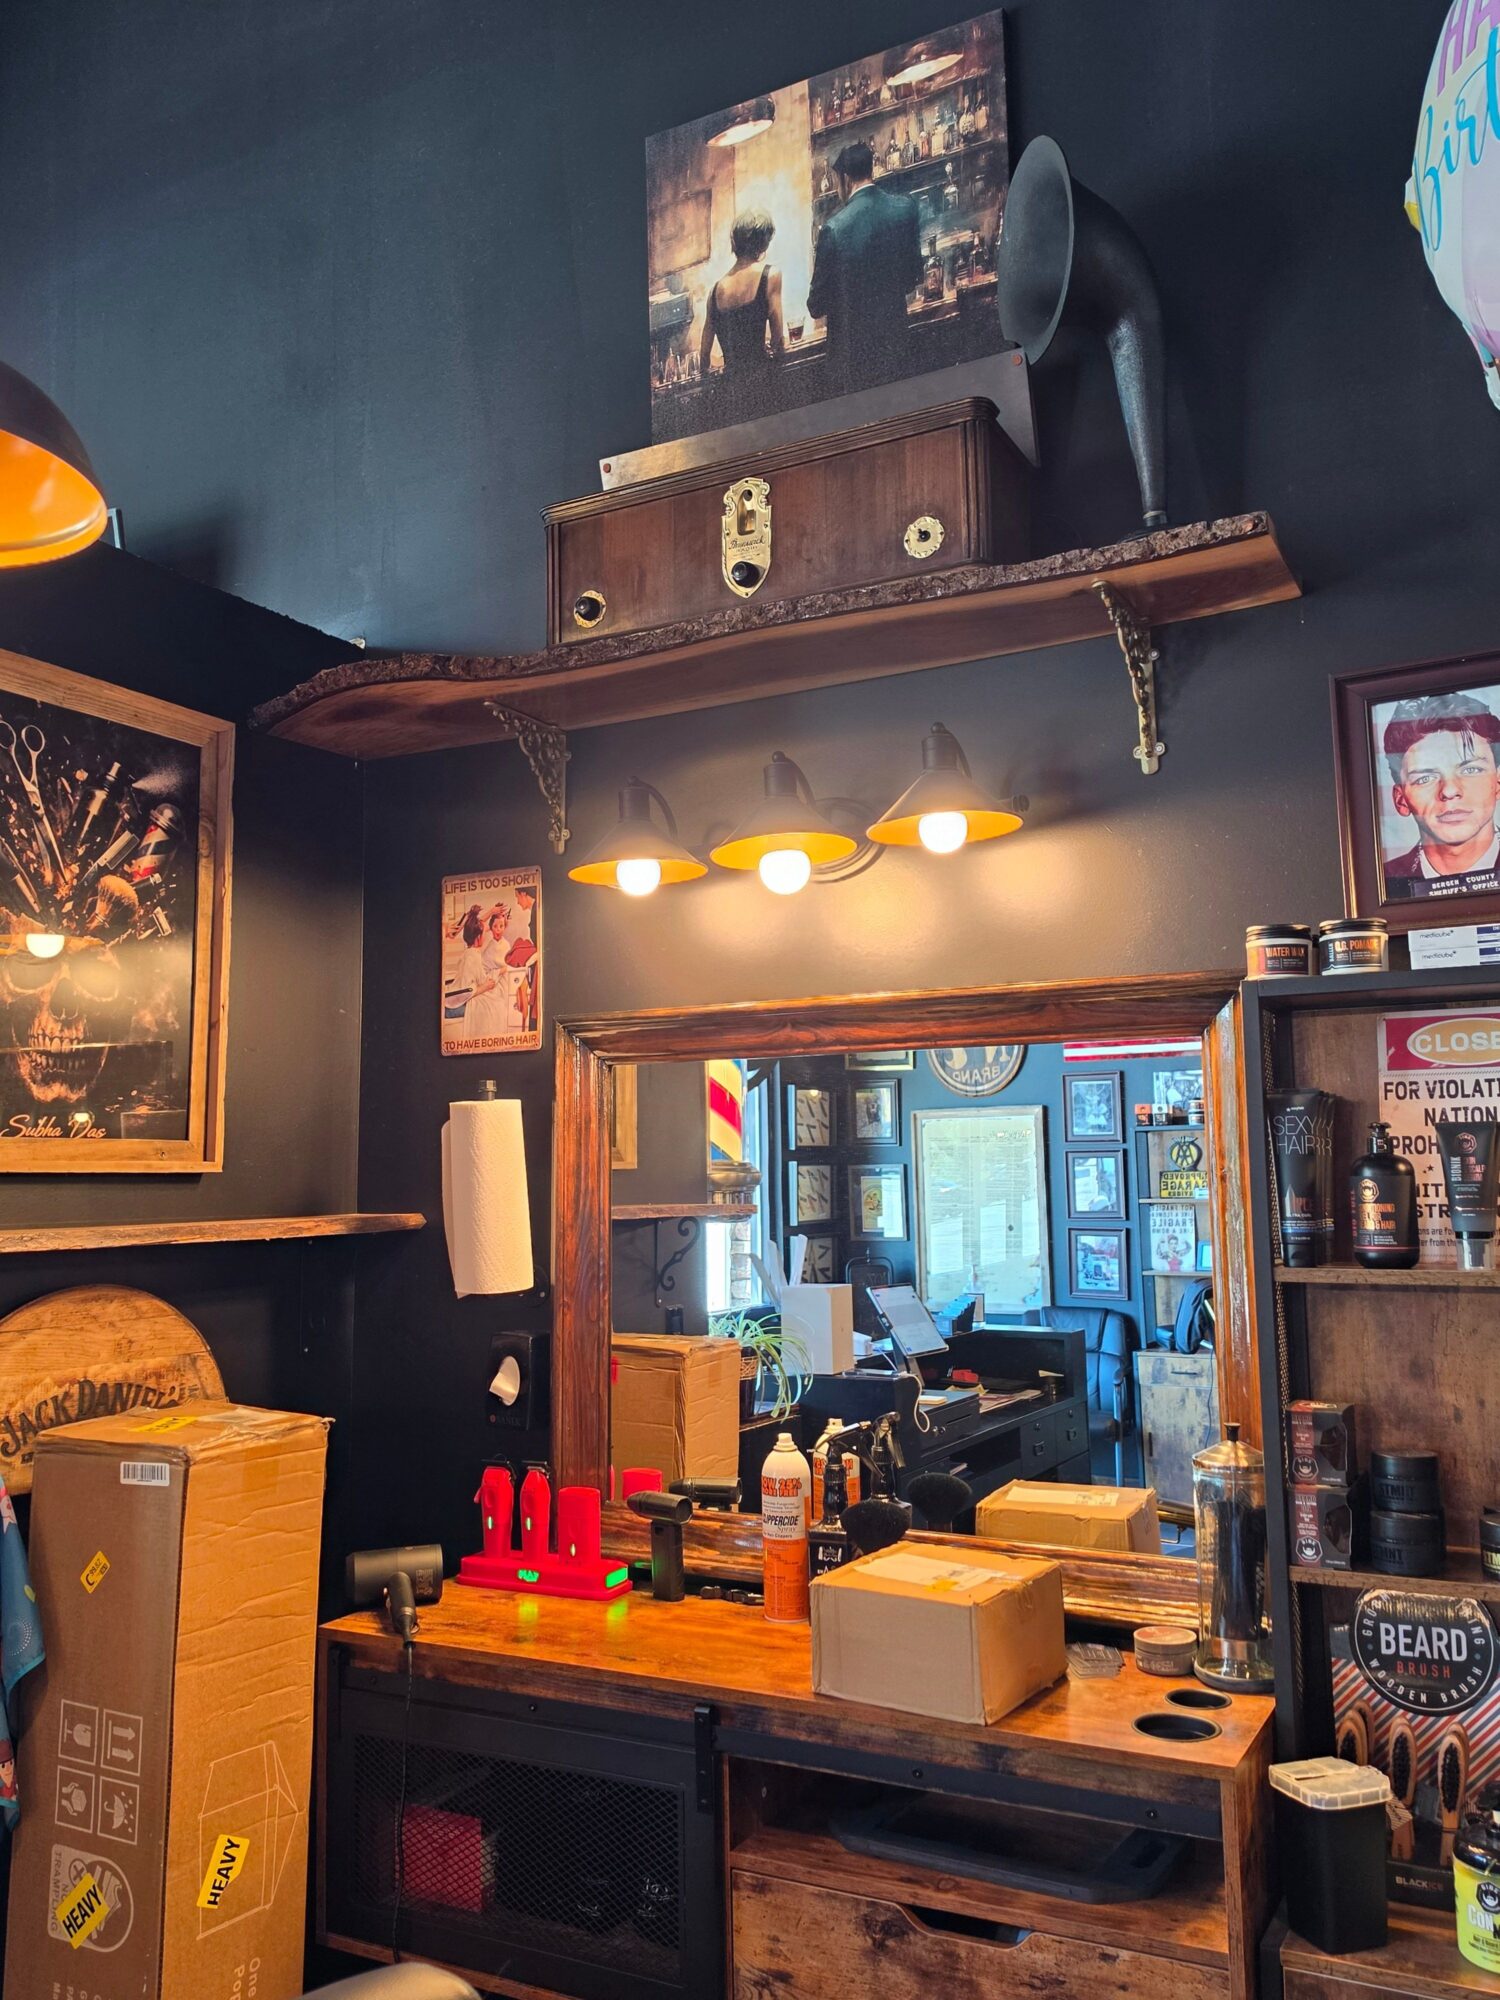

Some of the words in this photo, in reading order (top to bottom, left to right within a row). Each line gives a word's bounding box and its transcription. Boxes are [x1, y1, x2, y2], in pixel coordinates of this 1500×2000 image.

[1437, 0, 1500, 96] HA
[445, 881, 467, 895] LIFE
[468, 881, 478, 891] IS
[479, 877, 501, 889] TOO
[501, 873, 538, 888] SHORT
[1431, 879, 1460, 890] BERGEN
[1466, 873, 1496, 884] COUNTY
[1265, 946, 1291, 958] WATER
[445, 1041, 456, 1051] TO
[457, 1038, 481, 1049] HAVE
[481, 1035, 515, 1048] BORING
[515, 1033, 538, 1045] HAIR
[1415, 1031, 1500, 1054] CLOSE
[1384, 1080, 1420, 1101] FOR
[1273, 1115, 1317, 1136] SEXY
[1275, 1135, 1316, 1155] HAIR
[1450, 1156, 1462, 1182] BIONIK
[1429, 1238, 1446, 1247] from
[1431, 1228, 1443, 1236] are
[0, 1392, 76, 1458] JACK
[763, 1513, 800, 1527] LIPPERCIDE
[1380, 1622, 1468, 1662] BEARD
[1369, 1657, 1428, 1704] WOODEN
[1440, 1666, 1483, 1703] BRUSH
[1396, 1661, 1451, 1679] BRUSH
[207, 1838, 241, 1907] HEAVY
[62, 1883, 102, 1939] HEAVY
[248, 1956, 261, 1998] One
